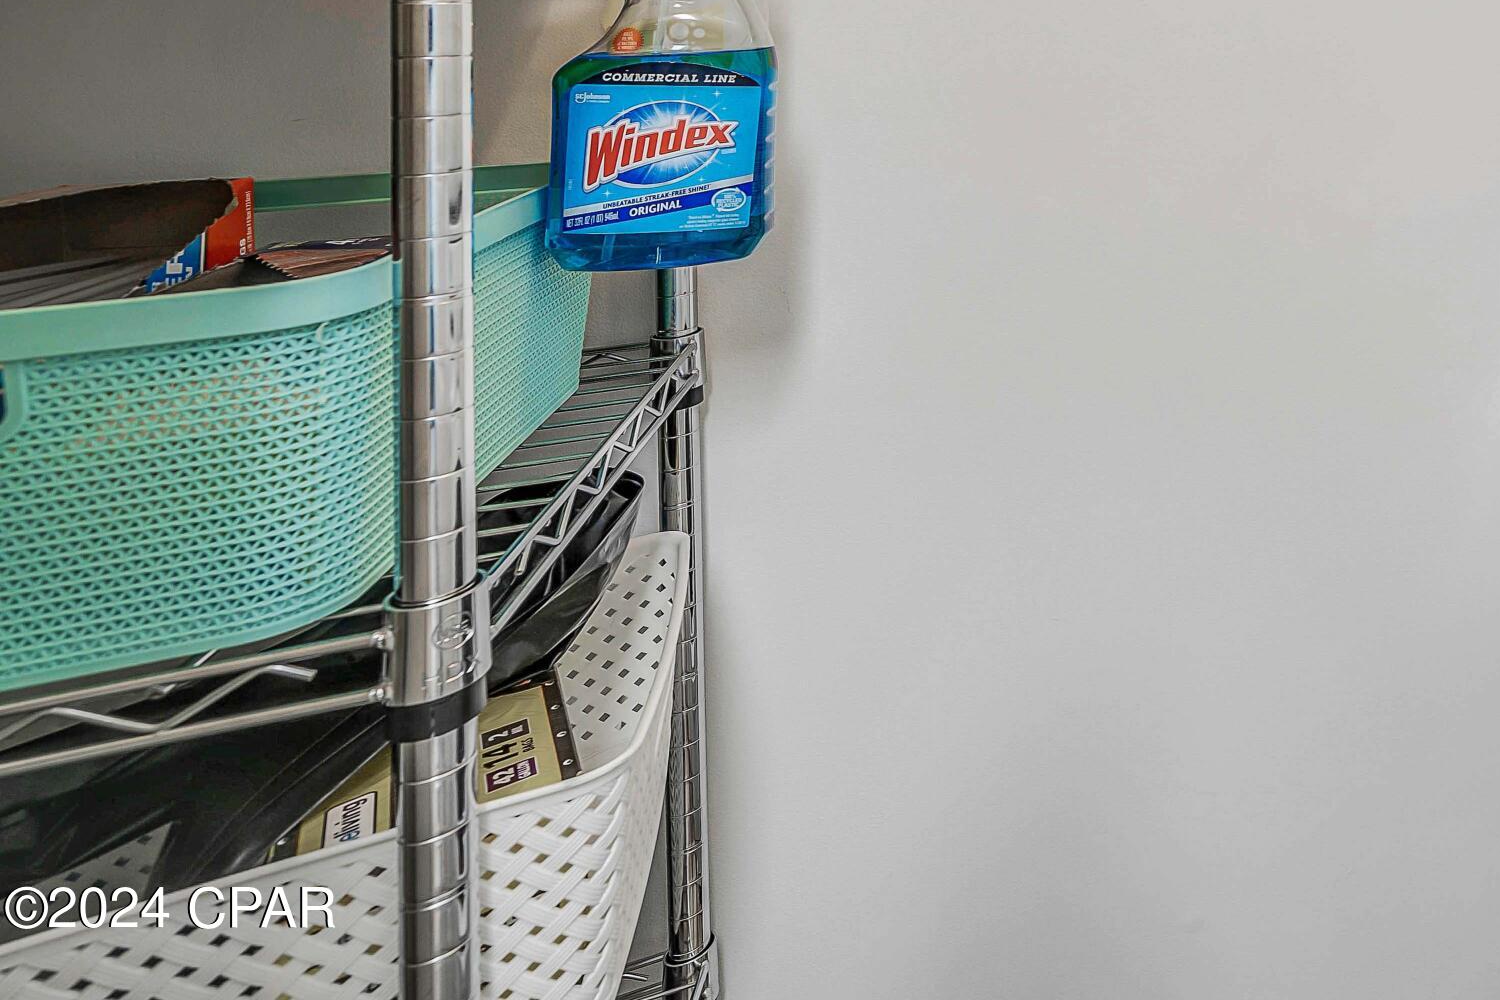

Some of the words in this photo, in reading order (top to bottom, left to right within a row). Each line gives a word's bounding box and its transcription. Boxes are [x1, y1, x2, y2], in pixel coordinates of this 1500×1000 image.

[602, 72, 699, 84] COMMERCIAL
[703, 73, 737, 84] LINE
[584, 116, 738, 190] Windex
[602, 197, 642, 209] UNBEATABLE
[644, 188, 686, 201] STREAK-FREE
[629, 200, 682, 217] ORIGINAL
[487, 729, 510, 742] 2
[520, 737, 536, 754] BAGS
[481, 741, 520, 770] 14
[491, 766, 516, 786] 42
